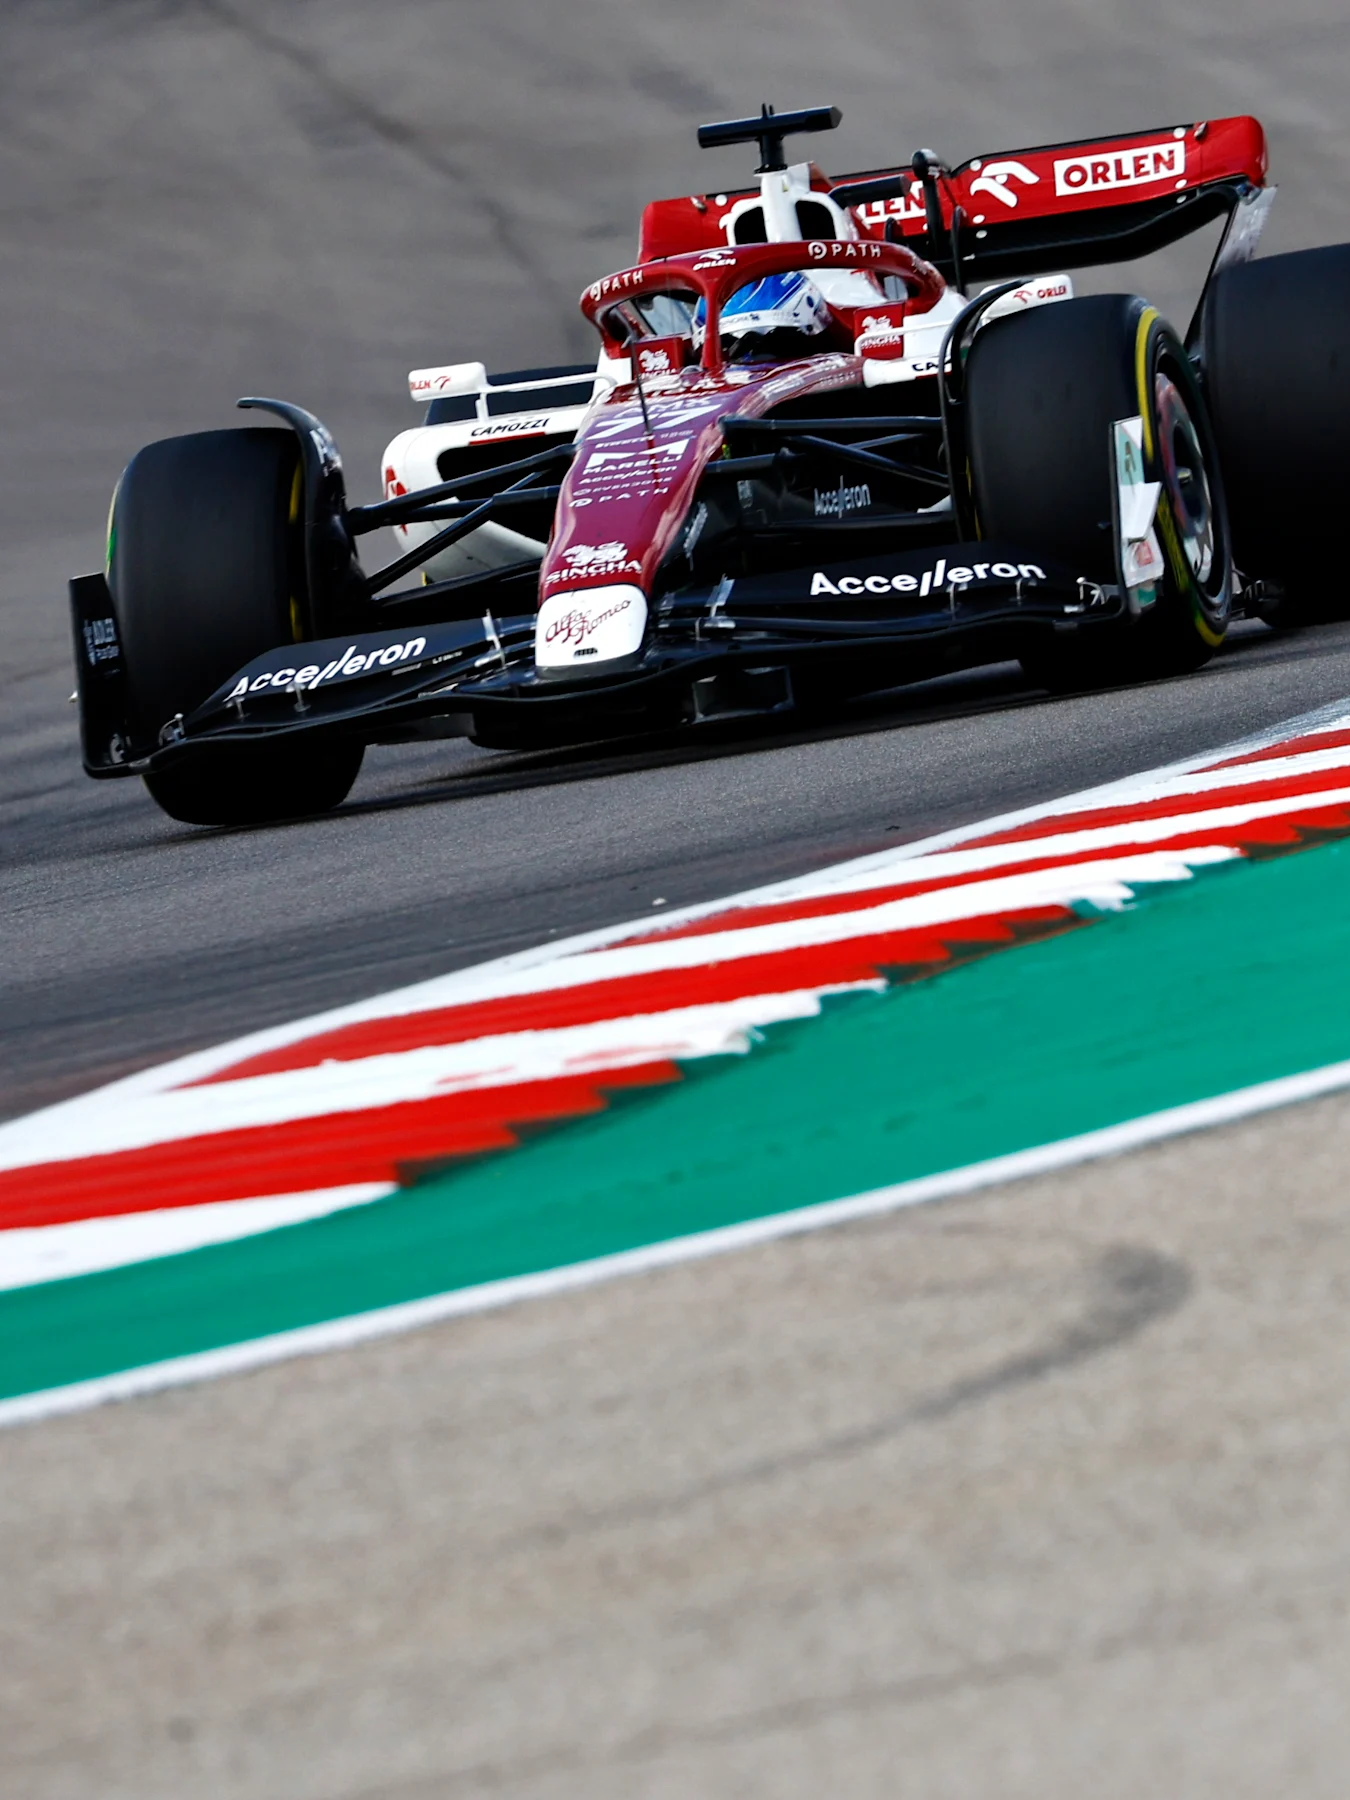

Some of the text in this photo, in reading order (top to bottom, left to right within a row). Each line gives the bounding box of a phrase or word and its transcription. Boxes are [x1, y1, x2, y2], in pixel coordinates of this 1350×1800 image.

[1063, 148, 1175, 188] ORLEN
[832, 243, 881, 258] PATH
[692, 258, 737, 271] ORLEN
[602, 269, 644, 294] PATH
[471, 418, 550, 437] CAMOZZI
[585, 403, 723, 441] 77
[578, 465, 678, 485] Accelleron
[582, 454, 683, 475] MARELLI
[598, 486, 669, 503] PATH
[814, 475, 872, 519] Accelleron
[545, 559, 643, 585] SINGHA
[810, 559, 1047, 597] Accelleron
[545, 600, 632, 645] Alfa Romeo
[223, 636, 427, 702] Accelleron
